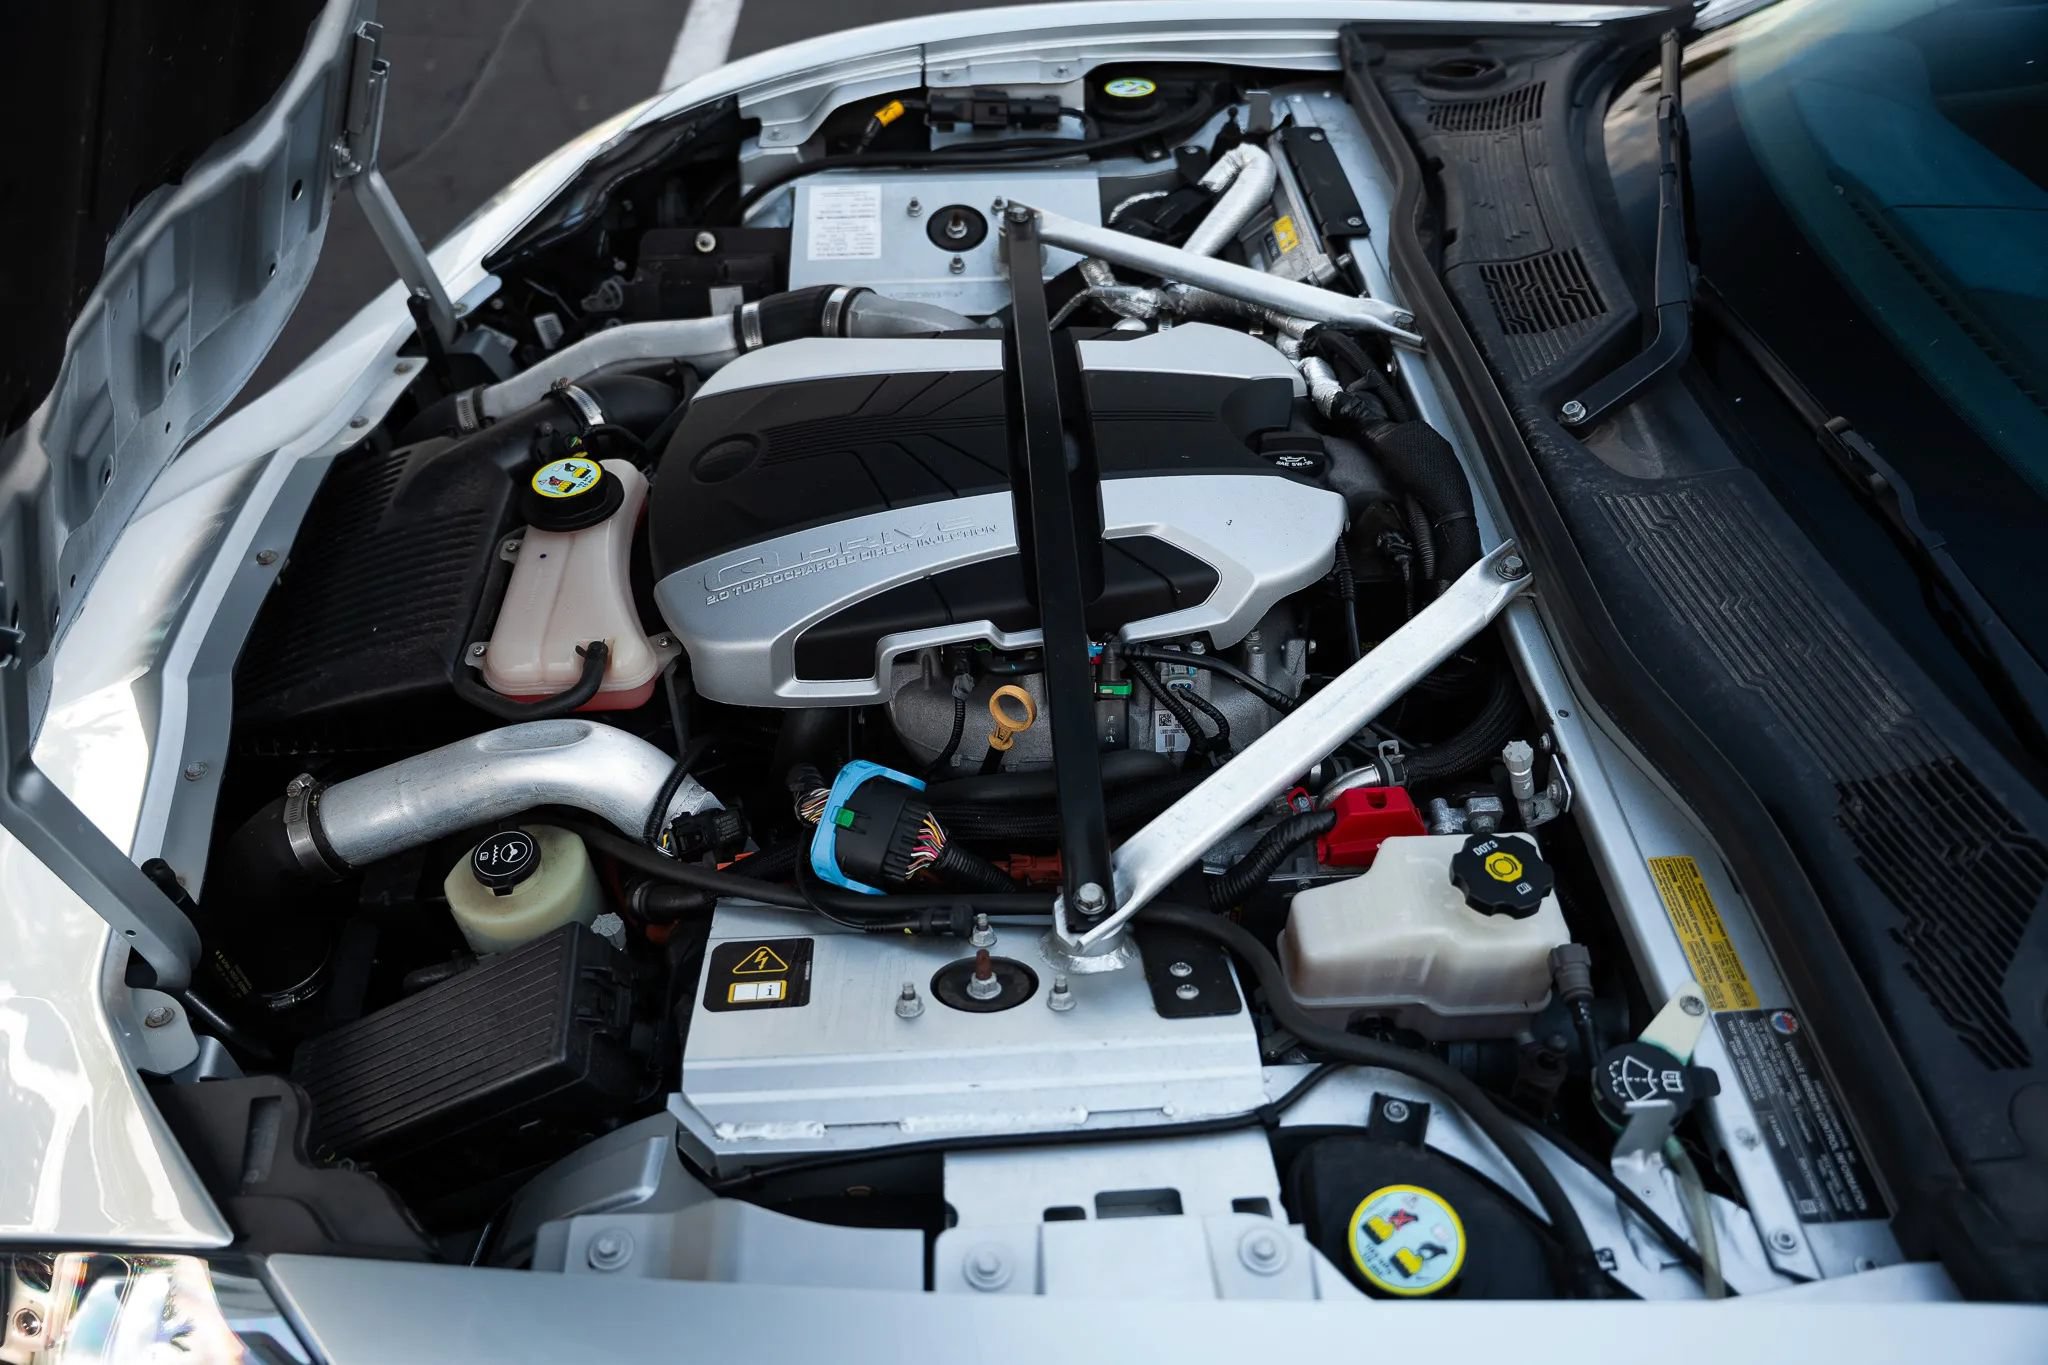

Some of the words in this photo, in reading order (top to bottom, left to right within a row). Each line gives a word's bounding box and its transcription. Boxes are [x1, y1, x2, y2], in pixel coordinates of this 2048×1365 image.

[733, 556, 856, 597] TURBOCHARGED
[858, 541, 911, 562] DIRECT
[915, 523, 999, 548] INJECTION
[799, 516, 974, 566] DRIVE
[1784, 1042, 1805, 1073] VEHICLE
[1798, 1074, 1821, 1110] EMISSION
[1816, 1112, 1840, 1151] CONTROL
[1837, 1153, 1867, 1210] INFORMATION
